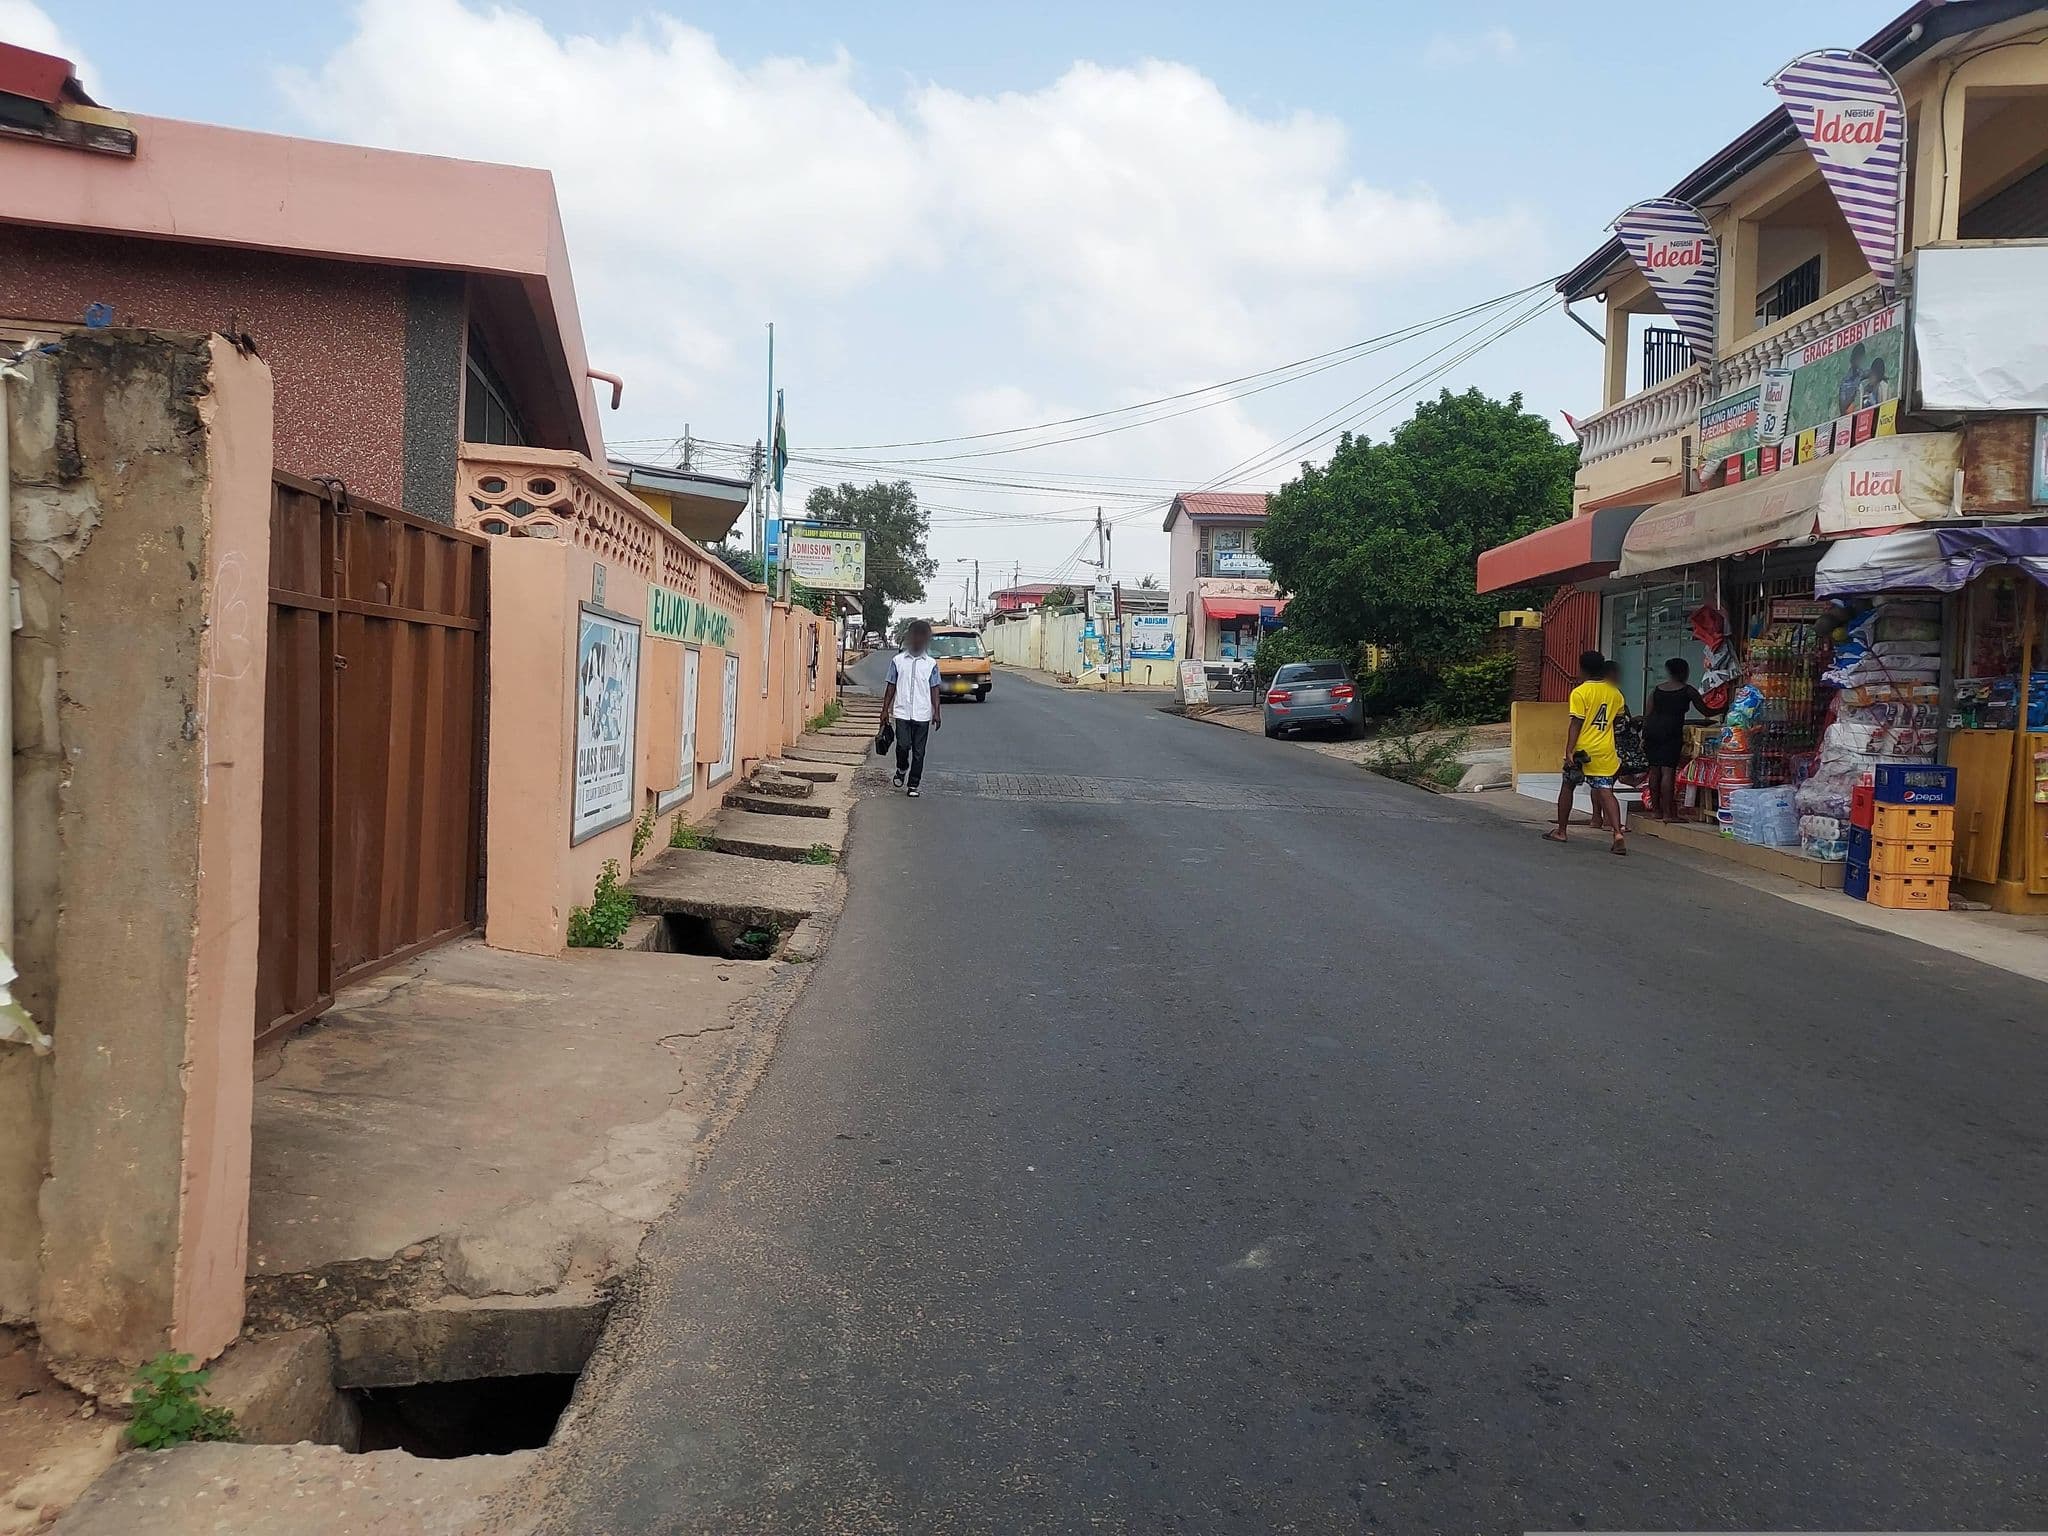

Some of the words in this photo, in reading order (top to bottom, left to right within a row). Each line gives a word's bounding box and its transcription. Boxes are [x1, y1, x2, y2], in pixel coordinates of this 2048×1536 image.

[1813, 109, 1885, 144] Ideal
[1647, 240, 1703, 268] Ideal
[1803, 337, 1834, 364] GRACE
[1836, 319, 1871, 350] DEBBY
[1873, 308, 1895, 335] ENT
[1726, 398, 1760, 419] MOMENTS
[1702, 420, 1726, 440] SPECIAL
[1727, 414, 1747, 431] SINCE
[1849, 469, 1902, 497] Ideal
[792, 543, 832, 556] ADMISSION
[653, 588, 690, 639] ELIJOY
[1590, 703, 1608, 732] 4
[579, 747, 598, 778] CLASS
[1915, 793, 1943, 801] pepsi
